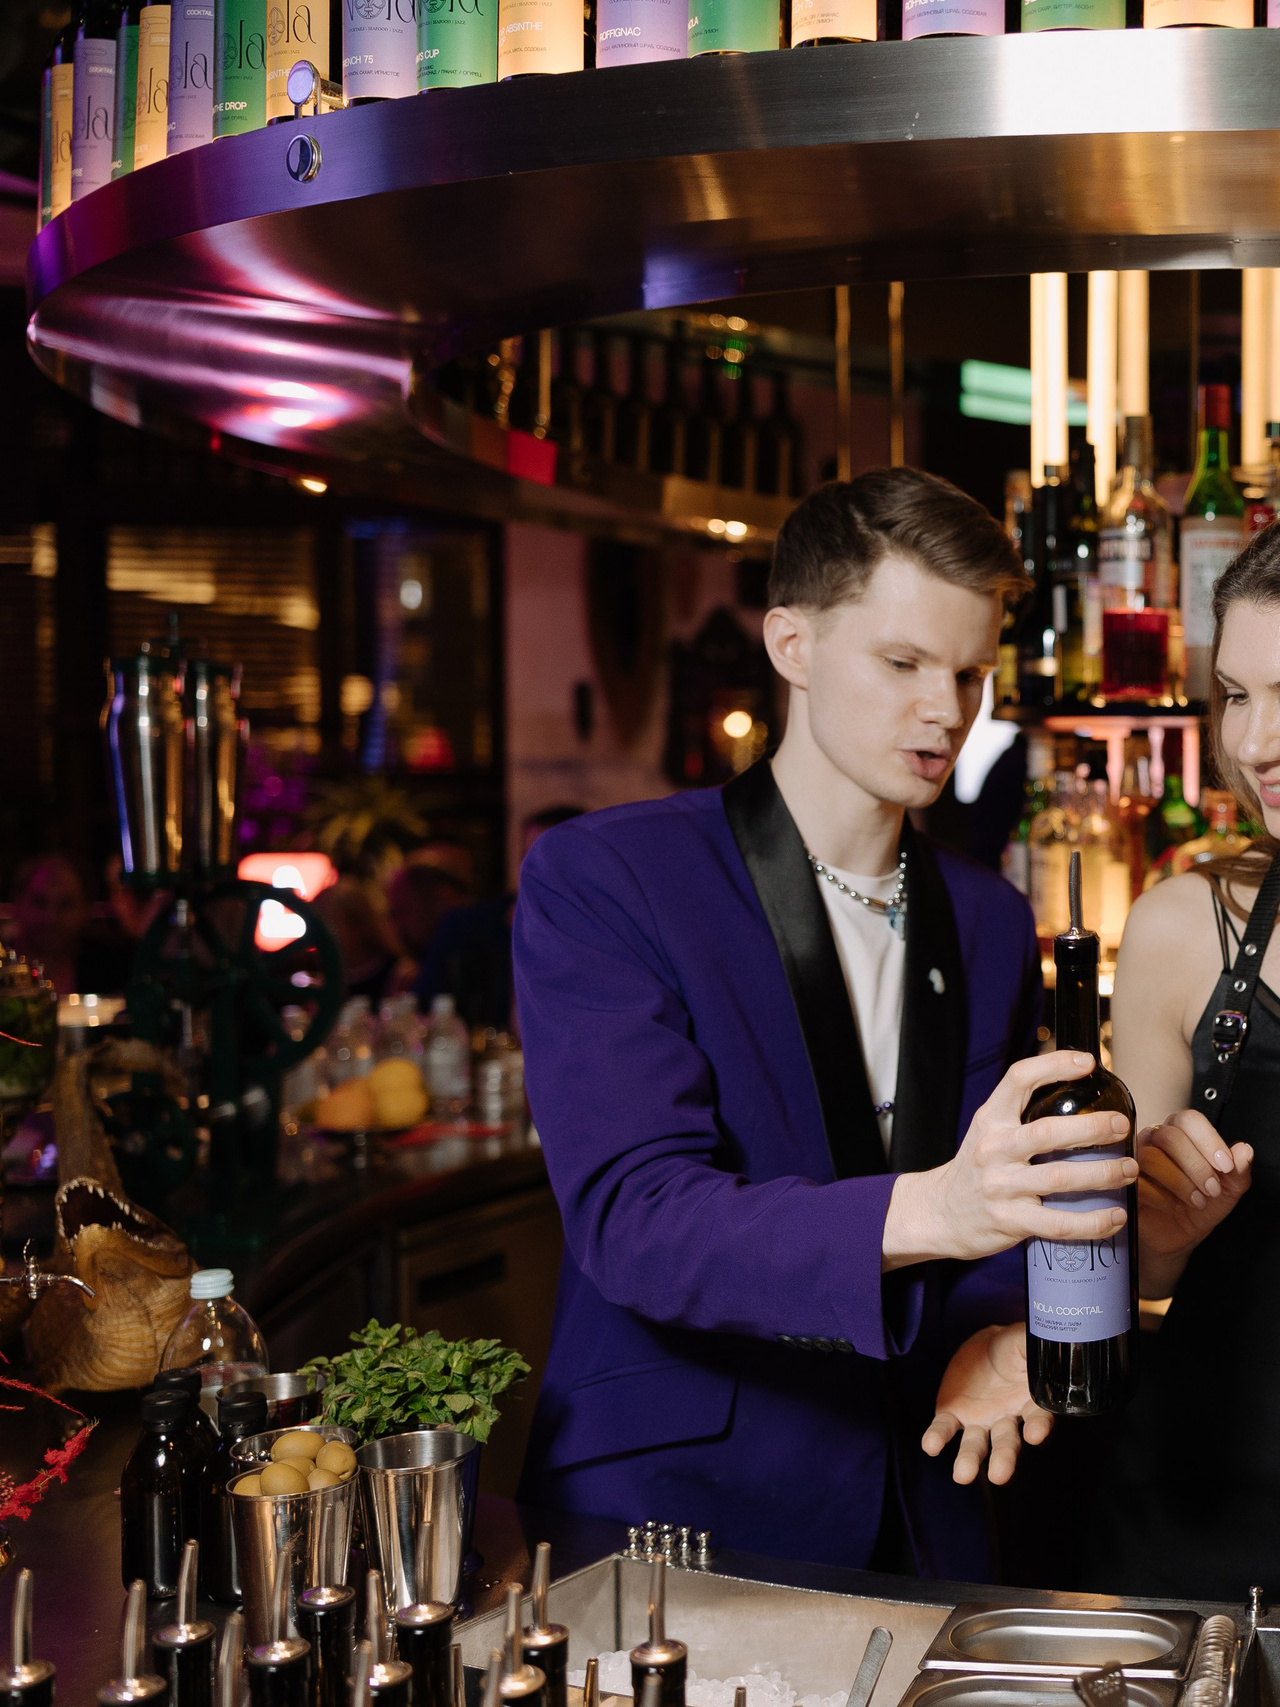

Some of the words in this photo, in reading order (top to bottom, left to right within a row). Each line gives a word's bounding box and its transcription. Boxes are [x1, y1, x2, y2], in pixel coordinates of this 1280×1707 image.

[506, 21, 543, 34] ABSINTHE
[599, 26, 642, 43] ROFFIGNAC
[363, 54, 374, 64] 75
[424, 48, 440, 60] CUP
[224, 101, 248, 111] DROP
[1033, 1300, 1054, 1314] NOLA
[1055, 1305, 1104, 1316] COCKTAIL
